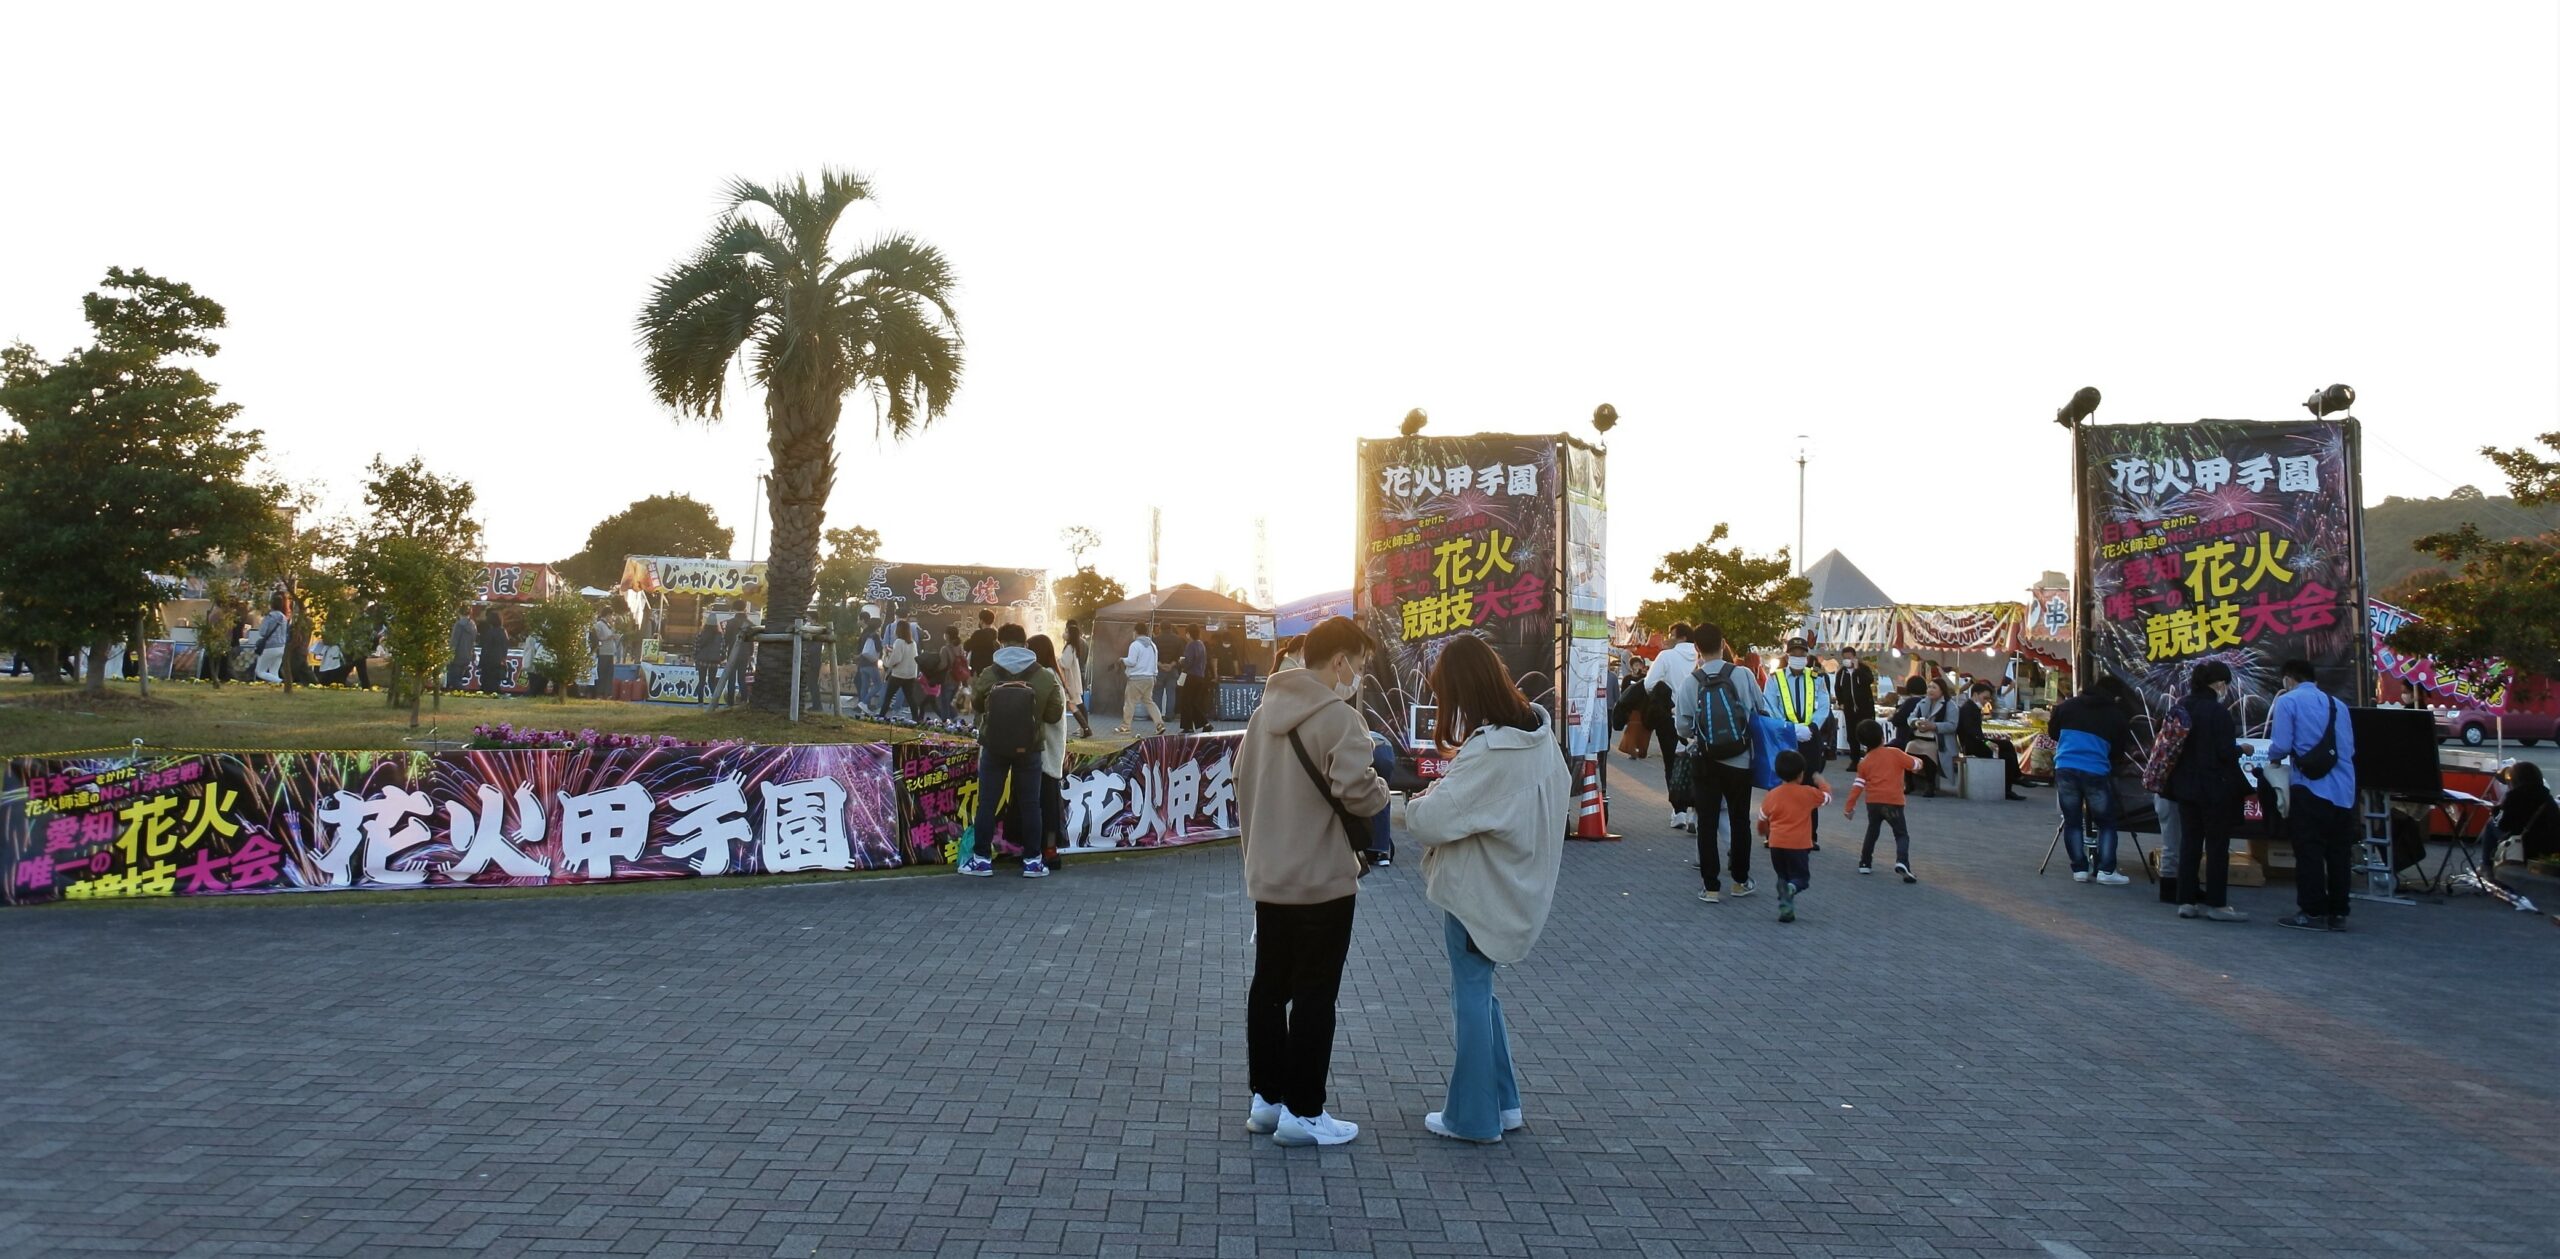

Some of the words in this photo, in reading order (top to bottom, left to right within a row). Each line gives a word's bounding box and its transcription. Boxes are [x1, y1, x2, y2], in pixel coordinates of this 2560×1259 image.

[1381, 461, 1538, 497] 花火甲子園
[2110, 452, 2320, 494] 花火甲子園
[662, 563, 758, 590] じゃがバター
[1386, 550, 1430, 578] 愛知
[1433, 529, 1515, 590] 花火
[2123, 553, 2181, 590] 愛知
[2184, 532, 2293, 602] 花火
[2045, 596, 2069, 635] 串
[2105, 590, 2183, 621] 唯一の
[1061, 746, 1235, 849] 花火甲子
[44, 811, 115, 853] 愛知
[116, 782, 239, 865] 花火
[308, 769, 855, 886] 花火甲子園
[16, 852, 112, 890] 唯一の
